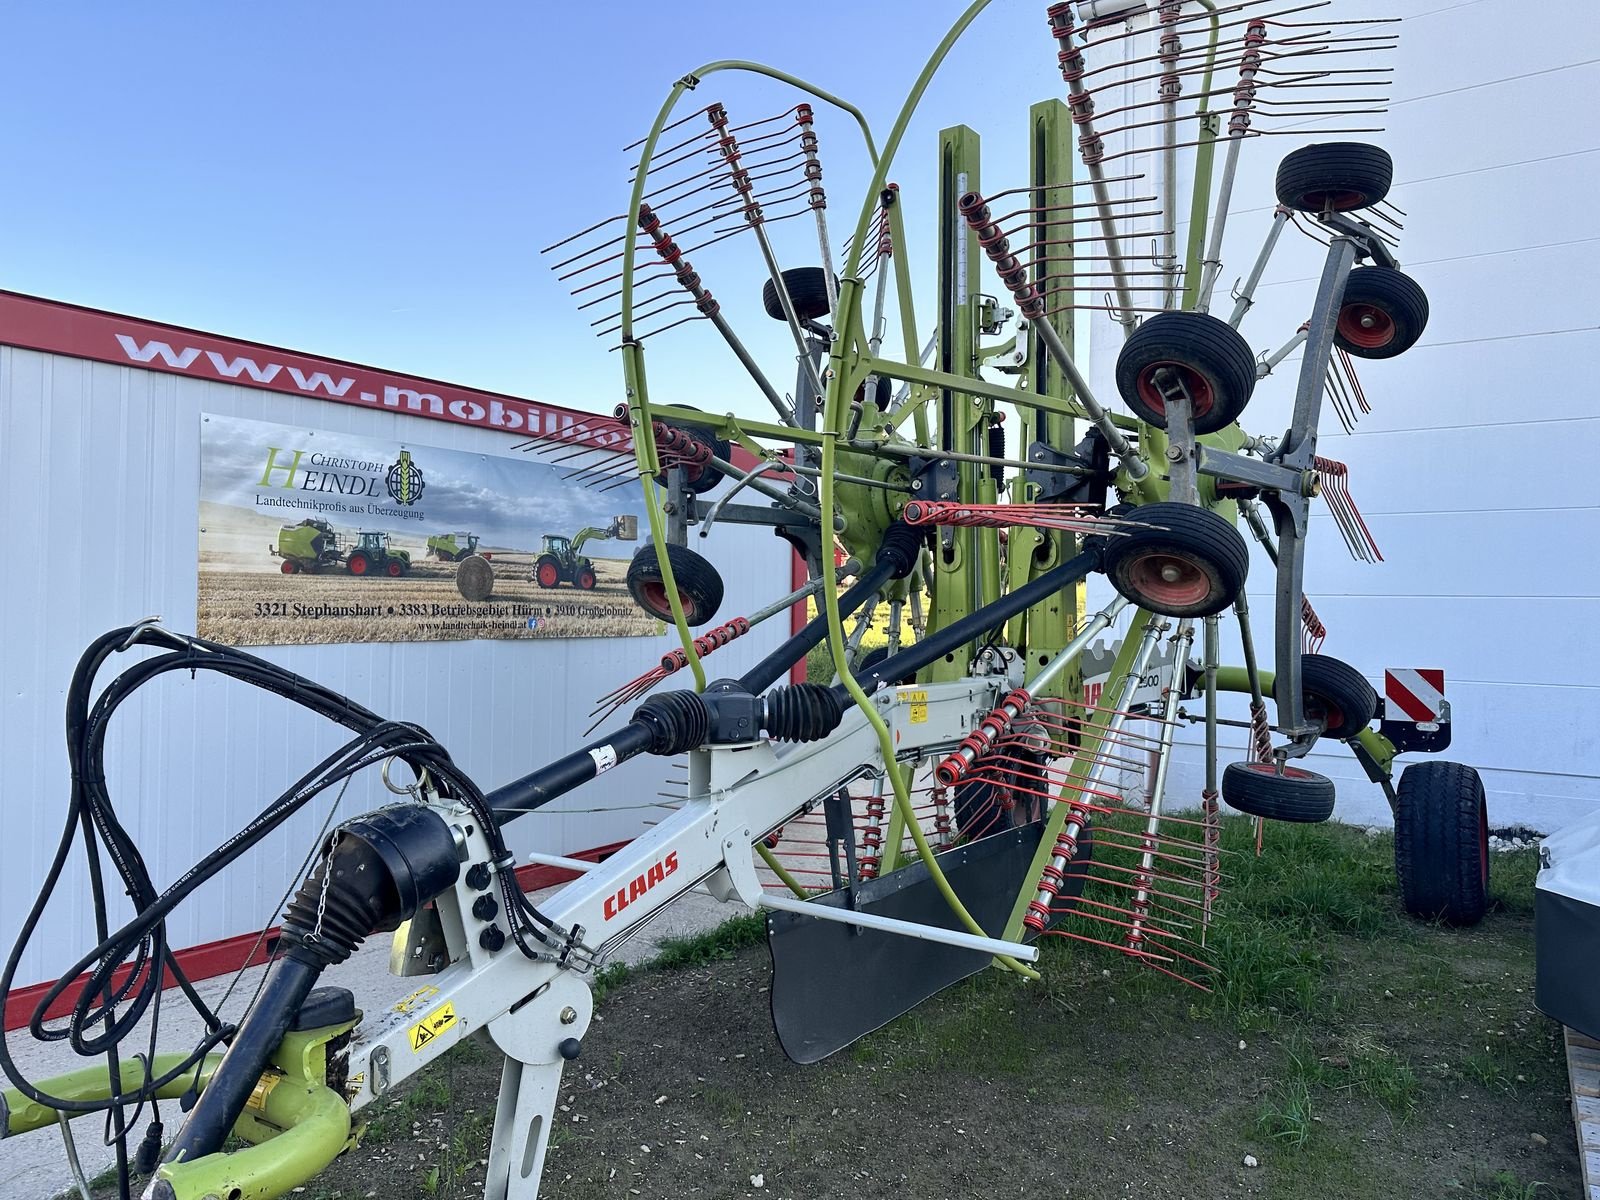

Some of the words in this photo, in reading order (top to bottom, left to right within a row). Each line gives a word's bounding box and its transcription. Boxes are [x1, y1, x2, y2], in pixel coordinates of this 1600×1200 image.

[256, 446, 380, 498] HEINDL
[310, 452, 384, 472] CHRISTOPH
[256, 494, 346, 513] Landtechnikprofis
[350, 504, 365, 514] aus
[367, 503, 424, 521] Überzeugung
[254, 602, 287, 617] 3321
[292, 602, 382, 619] Stephanshart
[400, 603, 428, 617] 3383
[432, 604, 508, 618] Betriebsgebiet
[512, 604, 542, 616] Hürm
[554, 605, 576, 616] 3910
[578, 605, 633, 618] Großglobnitz
[418, 620, 527, 631] www.landtechnik-heindl.at
[604, 850, 678, 922] CLAAS
